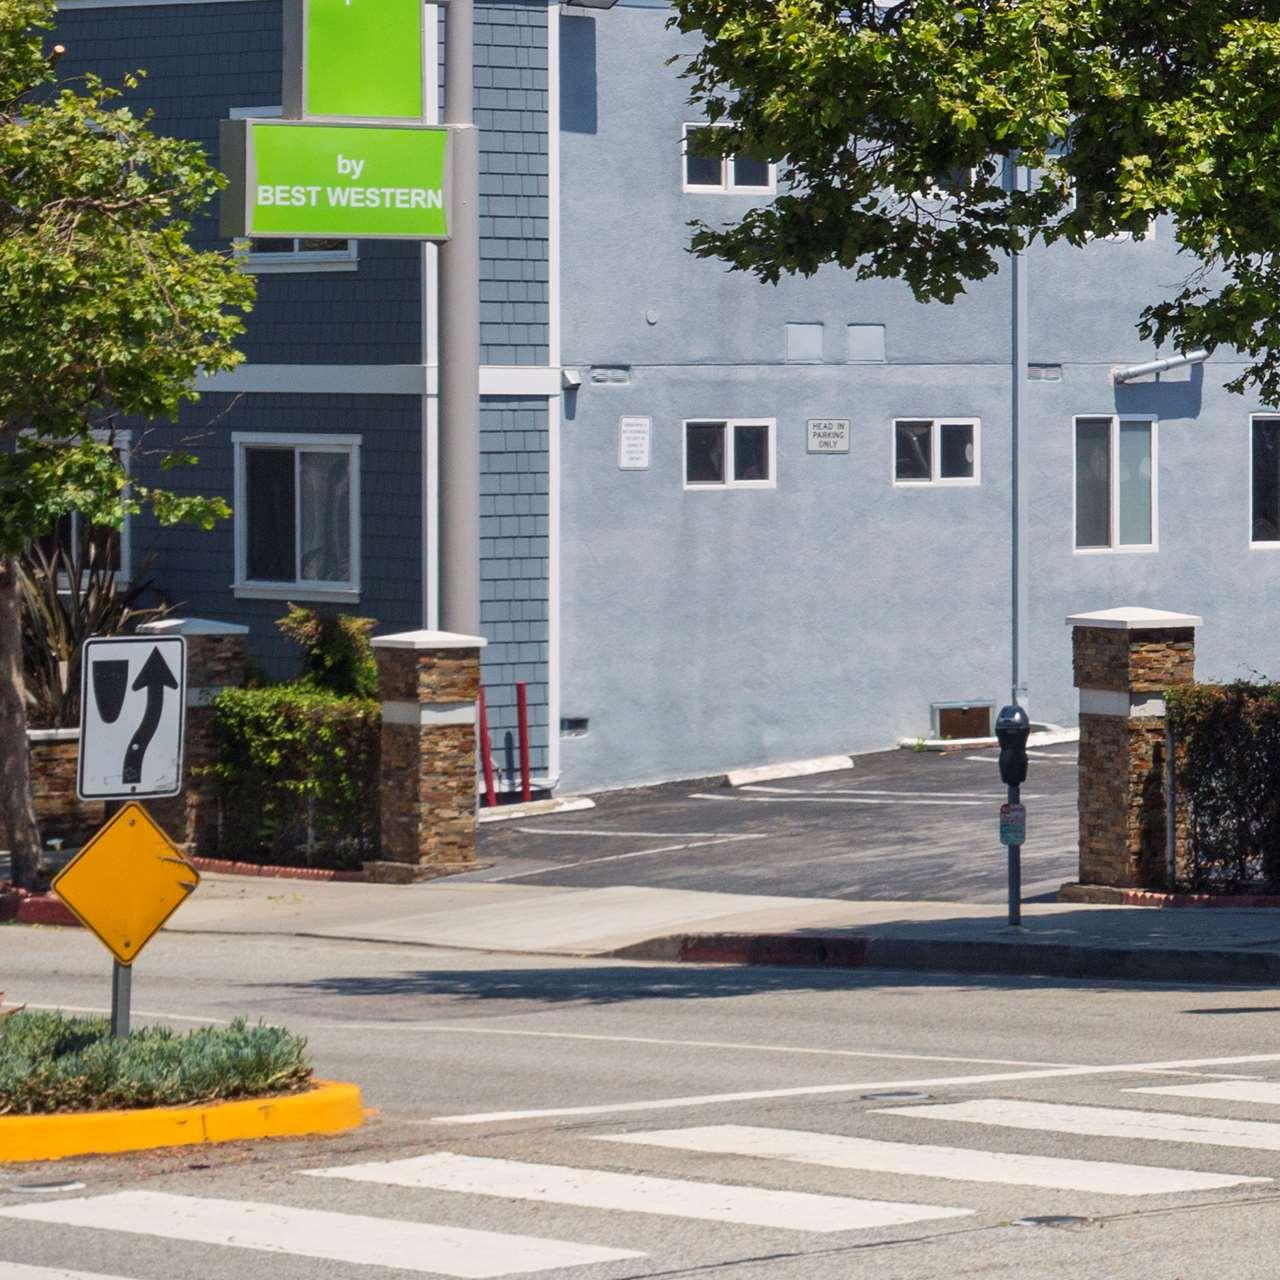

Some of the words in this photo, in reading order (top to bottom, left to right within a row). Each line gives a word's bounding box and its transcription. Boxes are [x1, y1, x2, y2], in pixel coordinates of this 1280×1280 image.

[337, 154, 365, 179] by
[257, 185, 320, 206] BEST
[326, 187, 443, 209] WESTERN
